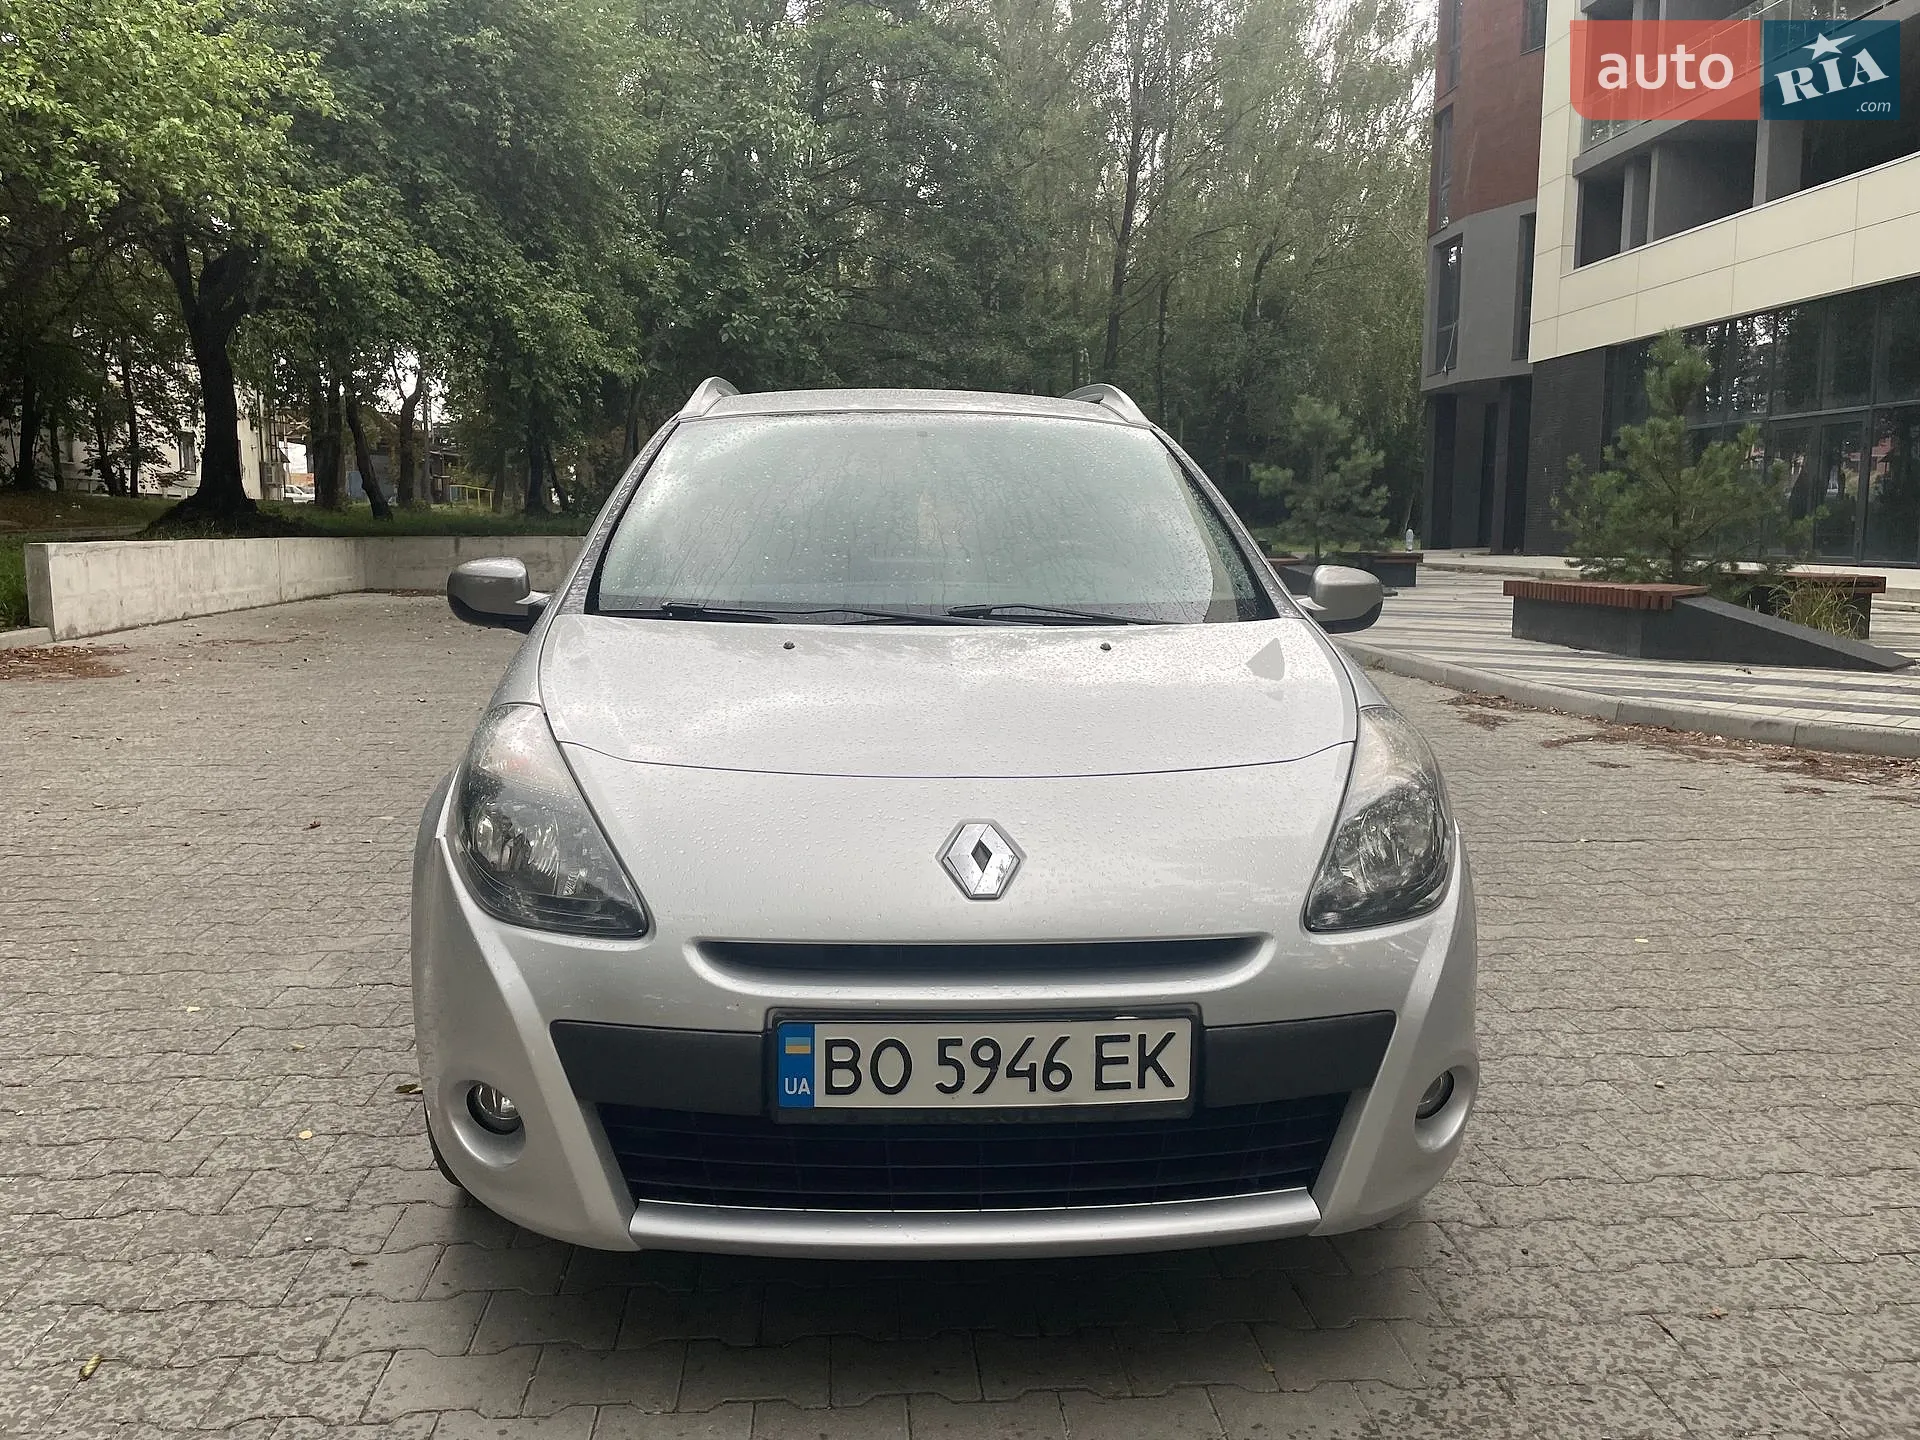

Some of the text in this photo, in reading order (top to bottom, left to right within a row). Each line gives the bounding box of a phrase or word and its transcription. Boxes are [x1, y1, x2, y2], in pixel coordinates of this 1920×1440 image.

[824, 1031, 1176, 1096] BO 5946 EK
[784, 1077, 811, 1095] UA
